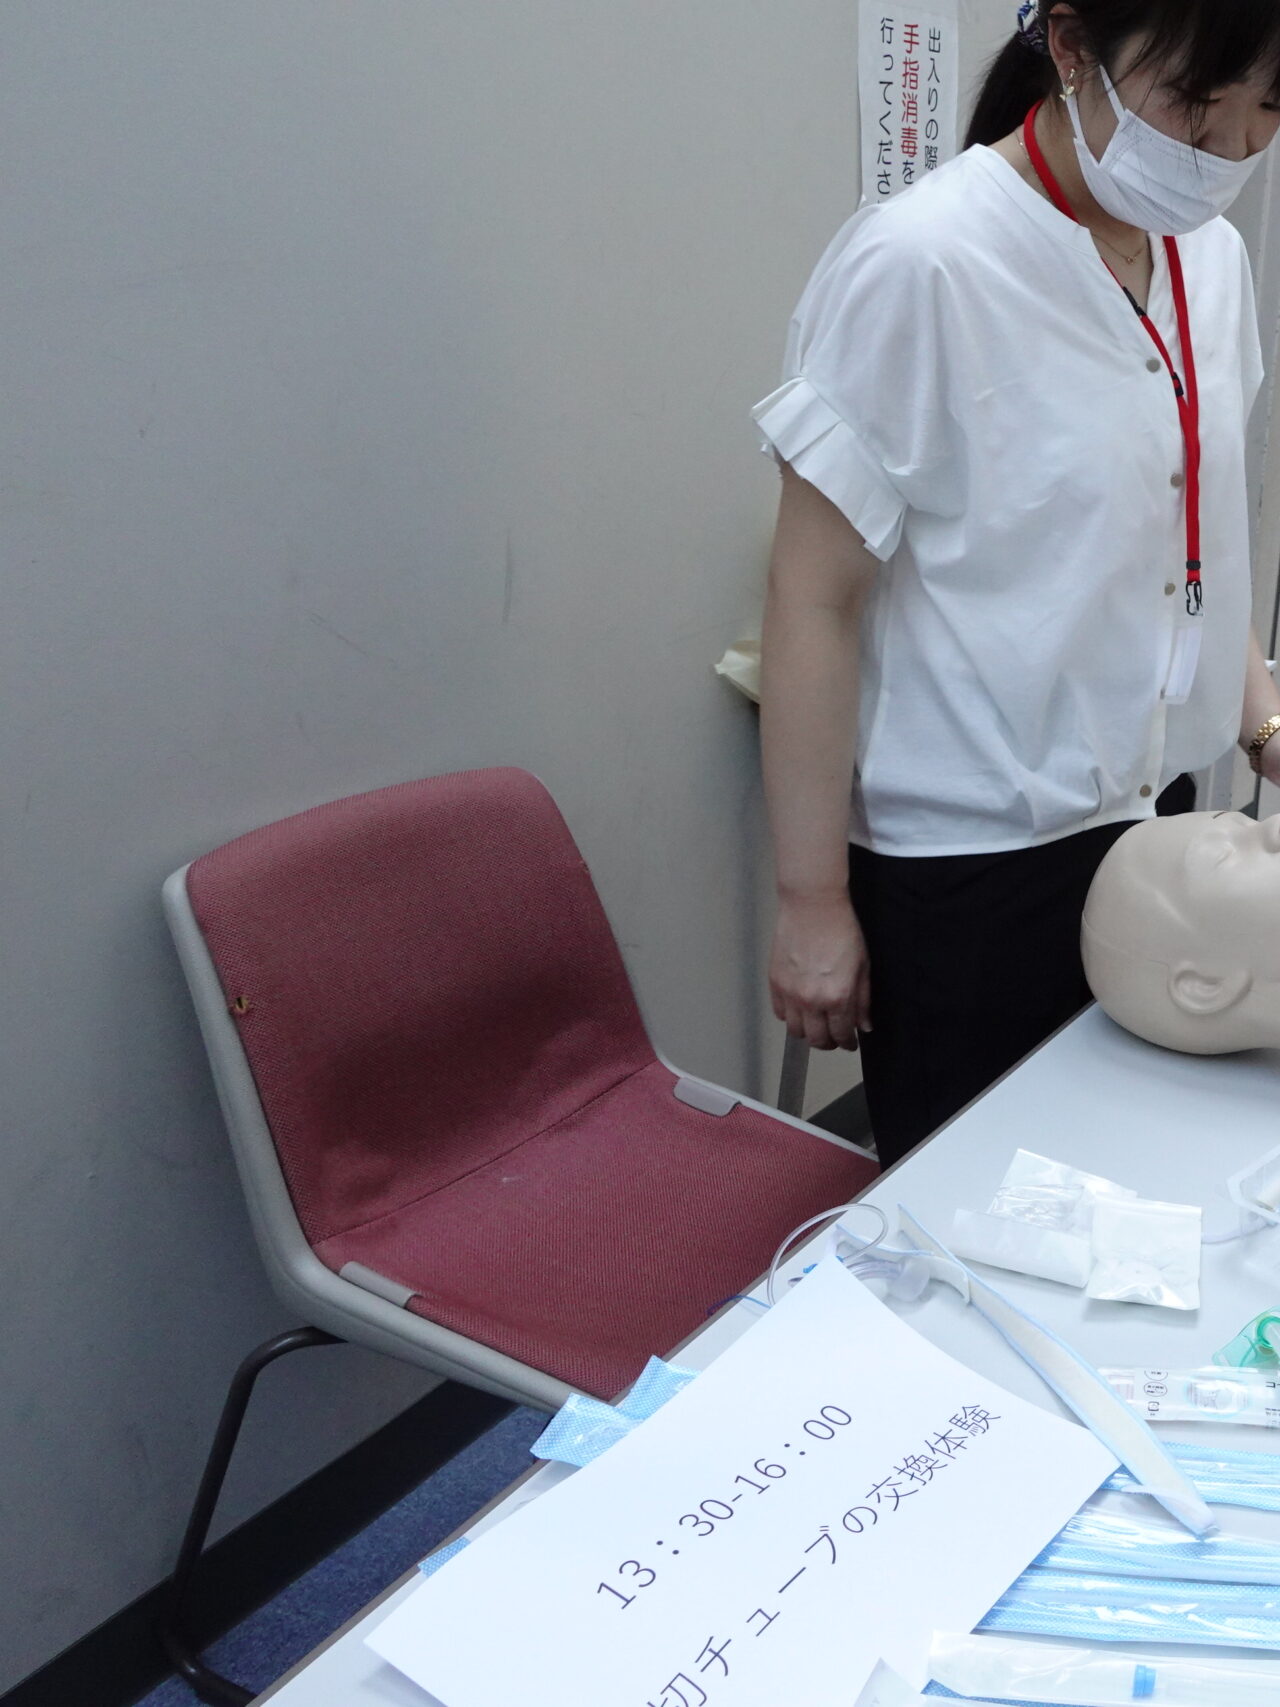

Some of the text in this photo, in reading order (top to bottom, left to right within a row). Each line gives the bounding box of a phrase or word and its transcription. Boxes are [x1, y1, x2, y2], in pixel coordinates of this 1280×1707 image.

[877, 17, 895, 203] 行ってくださ
[900, 24, 920, 185] 手指消毒を
[924, 27, 941, 170] 出入りの際
